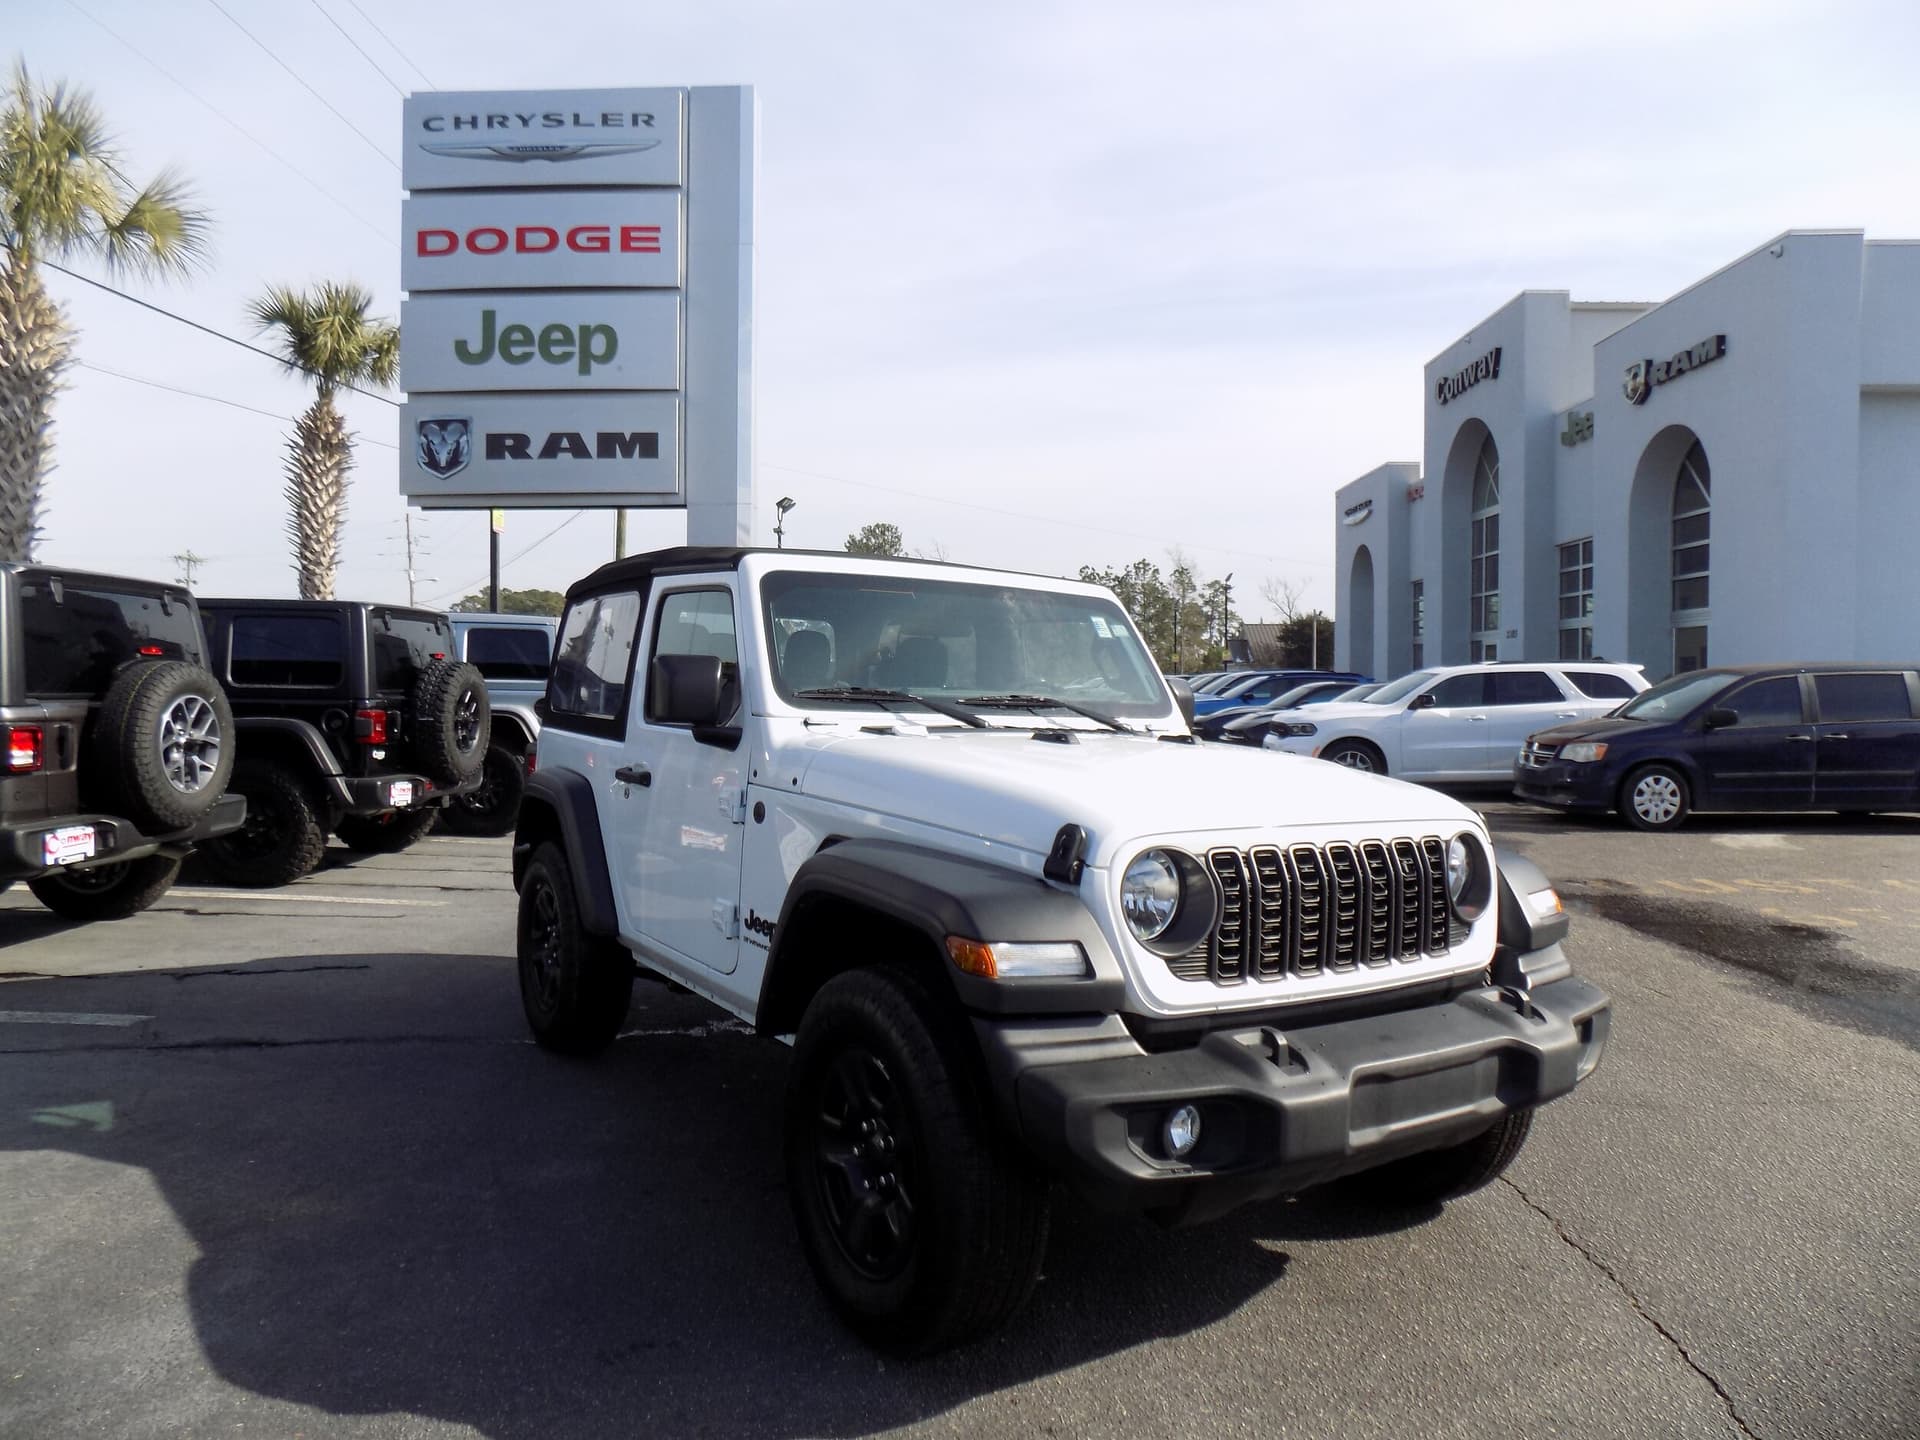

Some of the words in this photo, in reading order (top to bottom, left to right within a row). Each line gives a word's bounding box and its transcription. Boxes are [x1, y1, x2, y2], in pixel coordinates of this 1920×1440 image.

[422, 112, 656, 132] CHRYSLER
[416, 225, 662, 258] DODGE
[454, 309, 619, 376] Jeep
[1649, 334, 1726, 386] RAM
[1435, 347, 1502, 405] Conway
[485, 431, 659, 461] RAM
[1560, 411, 1594, 447] Jee
